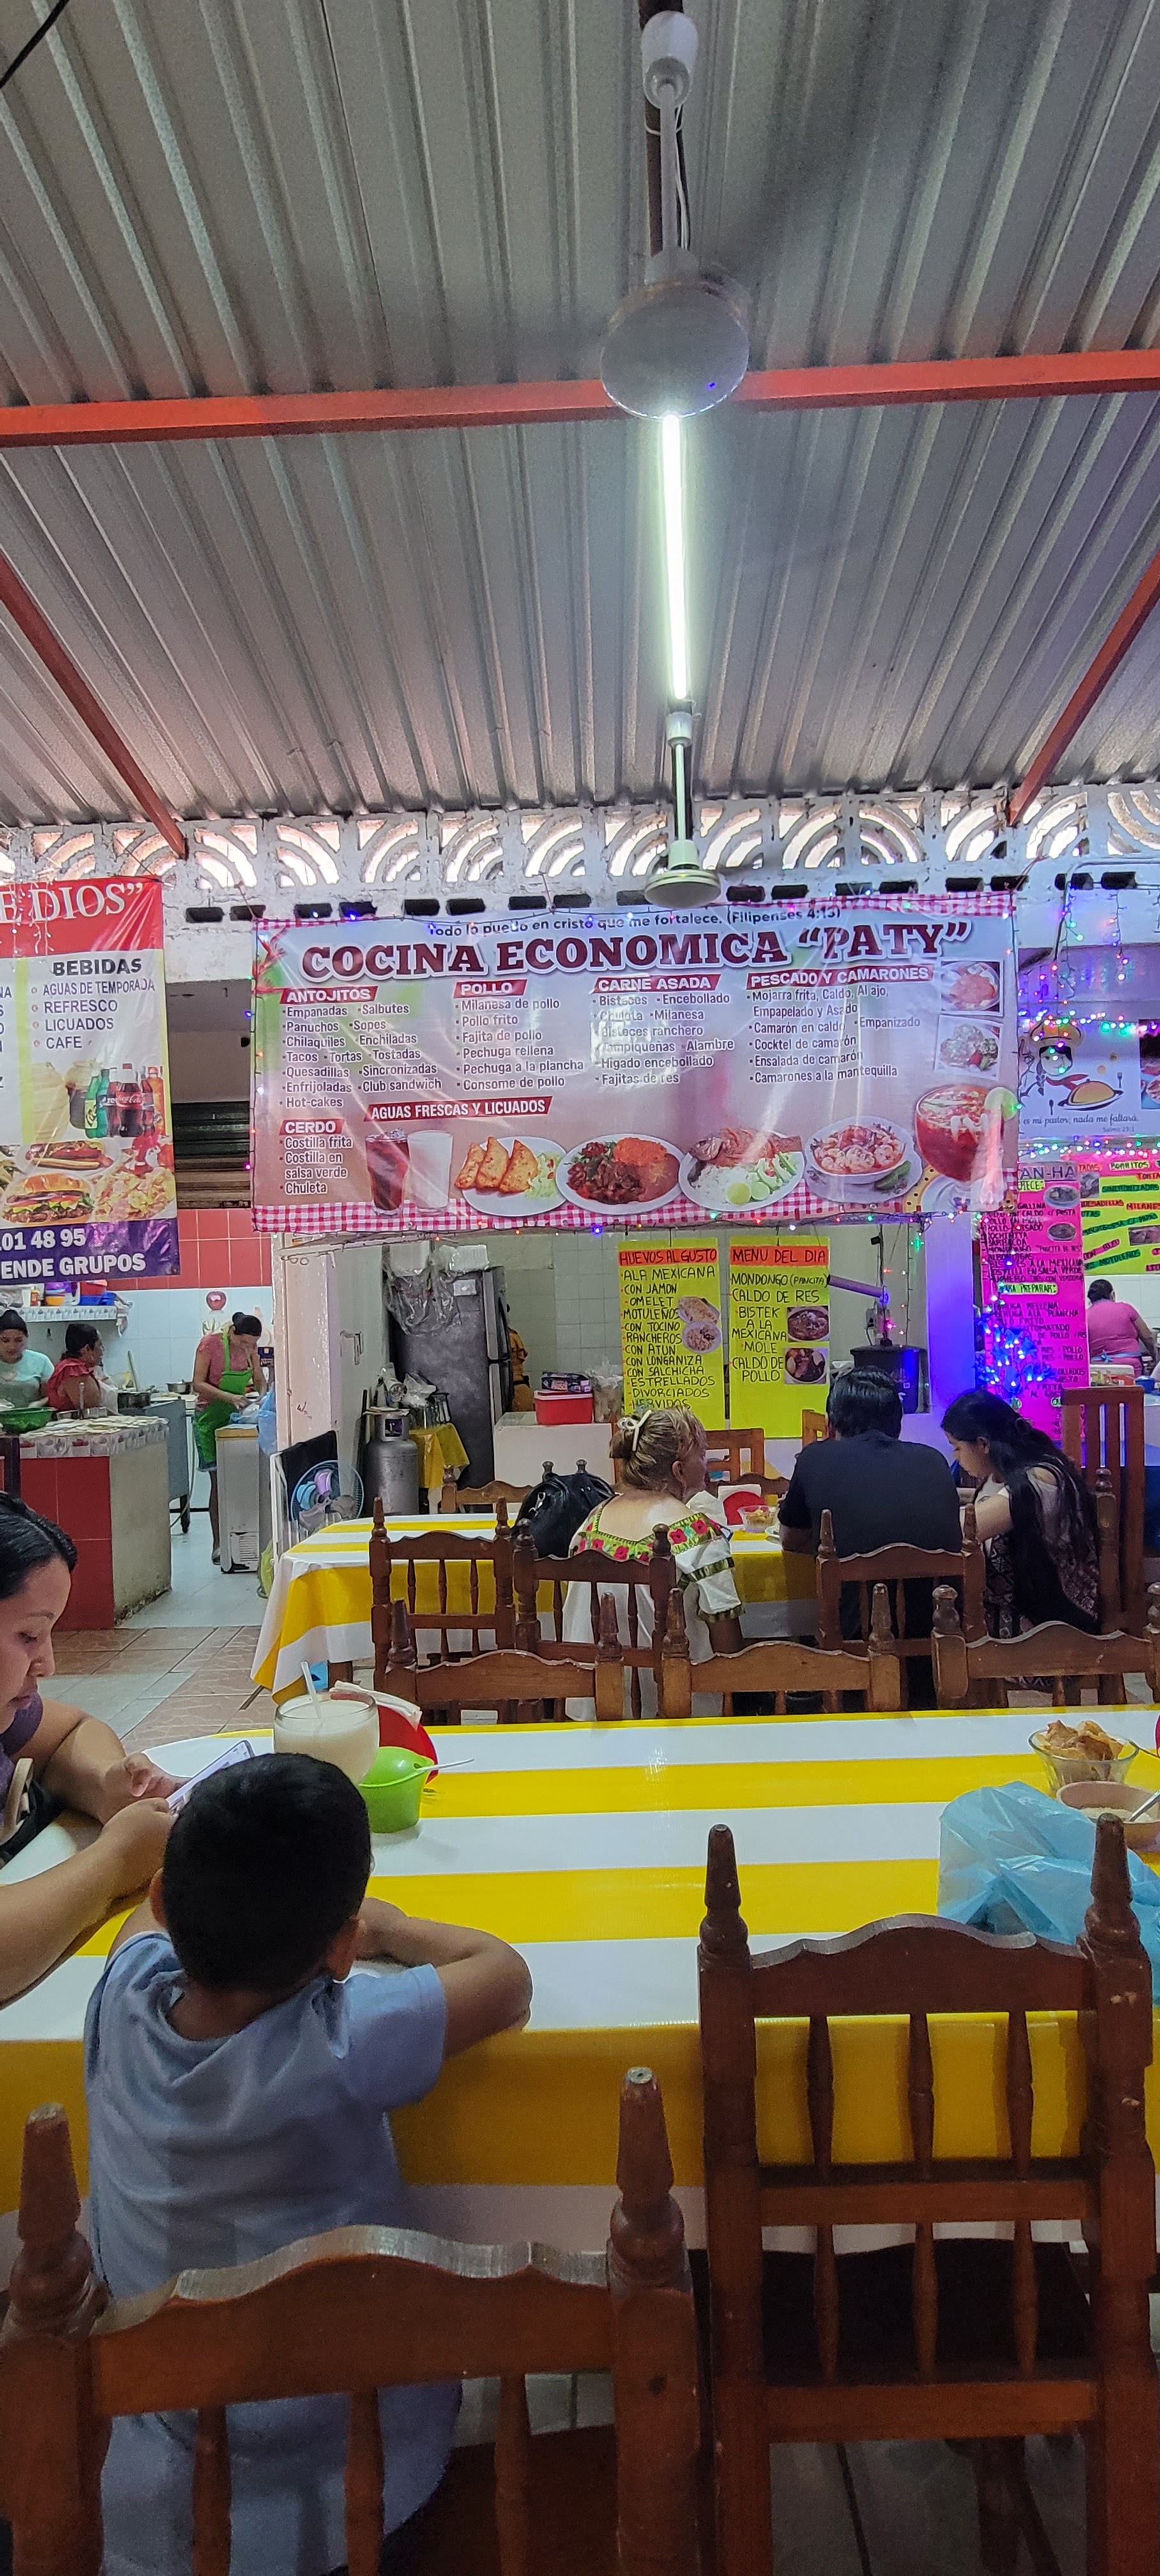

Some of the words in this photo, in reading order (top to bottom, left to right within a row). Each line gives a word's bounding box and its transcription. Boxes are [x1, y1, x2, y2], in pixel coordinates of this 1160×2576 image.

[533, 920, 549, 930] en
[554, 917, 593, 930] cristo
[598, 919, 624, 930] que
[630, 917, 650, 926] me
[655, 914, 722, 926] fortalece.
[728, 906, 802, 924] (Filipenses
[301, 942, 484, 979] COCINA
[497, 930, 788, 970] ECONOMICA
[53, 958, 141, 976] BEBIDAS
[599, 978, 652, 991] CARNE
[657, 977, 711, 989] ASADA
[751, 973, 818, 987] PESCADO
[822, 972, 832, 984] Y
[837, 968, 929, 983] CAMARONES
[43, 982, 77, 996] AGUAS
[80, 982, 92, 994] DE
[95, 979, 155, 993] TEMPORADA
[461, 982, 513, 995] POLLO
[753, 991, 791, 1002] Mojarra
[795, 989, 819, 1001] frita,
[823, 988, 853, 999] Caldo,
[858, 985, 869, 995] Al
[871, 986, 889, 997] ajo,
[287, 989, 370, 1002] ANTOJITOS
[663, 993, 729, 1004] Encebollado
[45, 999, 118, 1013] REFRESCO
[287, 1006, 347, 1019] Empanadas
[362, 1004, 409, 1015] Salbutes
[462, 1000, 510, 1011] Milanesa
[515, 999, 529, 1008] de
[533, 999, 560, 1010] pollo
[754, 1006, 813, 1018] Empapelado
[818, 1007, 823, 1018] y
[827, 1003, 857, 1016] Asado
[462, 1015, 489, 1027] Pollo
[493, 1015, 518, 1025] frito
[655, 1009, 704, 1020] Milanesa
[45, 1018, 114, 1031] LICUADOS
[287, 1022, 339, 1032] Panuchos
[354, 1020, 386, 1032] Sopes
[653, 1025, 703, 1036] ranchero
[754, 1022, 797, 1034] Camarón
[801, 1023, 814, 1032] en
[818, 1020, 845, 1032] caldo
[860, 1017, 920, 1030] Empanizado
[47, 1036, 82, 1048] CAFE
[287, 1036, 345, 1049] Chilaquiles
[360, 1034, 417, 1045] Enchiladas
[462, 1031, 492, 1043] Fajita
[497, 1031, 510, 1041] de
[515, 1030, 542, 1041] pollo
[755, 1038, 791, 1050] Cocktel
[796, 1038, 808, 1049] de
[812, 1036, 856, 1048] camarón
[687, 1039, 734, 1051] Alambre
[287, 1052, 317, 1062] Tacos
[329, 1052, 362, 1062] Tortas
[373, 1049, 420, 1060] Tostadas
[463, 1047, 510, 1059] Pechuga
[515, 1045, 554, 1055] rellena
[755, 1055, 798, 1066] Ensalada
[803, 1054, 814, 1064] de
[819, 1050, 863, 1065] camarón
[464, 1062, 511, 1075] Pechuga
[515, 1063, 521, 1072] a
[526, 1061, 535, 1071] la
[540, 1060, 583, 1072] plancha
[645, 1056, 712, 1068] encebollado
[287, 1067, 349, 1078] Quesadillas
[363, 1064, 437, 1077] Sincronizadas
[755, 1070, 812, 1083] Camarones
[816, 1071, 821, 1080] a
[825, 1070, 833, 1080] la
[838, 1065, 897, 1080] mantequilla
[287, 1082, 351, 1093] Enfrijoladas
[363, 1080, 386, 1092] Club
[390, 1079, 441, 1091] sandwich
[464, 1078, 515, 1091] Consome
[520, 1077, 533, 1087] de
[538, 1076, 564, 1088] pollo
[602, 1074, 639, 1086] Fajitas
[643, 1073, 656, 1083] de
[661, 1073, 679, 1083] res
[287, 1097, 343, 1107] Hot-cakes
[371, 1106, 411, 1119] AGUAS
[415, 1103, 468, 1117] FRESCAS
[471, 1103, 481, 1114] Y
[485, 1100, 545, 1114] LICUADOS
[285, 1121, 336, 1133] CERDO
[286, 1137, 324, 1148] Costilla
[328, 1137, 352, 1147] frita
[286, 1153, 324, 1164] Costilla
[329, 1154, 342, 1162] en
[286, 1167, 312, 1178] salsa
[315, 1167, 347, 1177] verde
[286, 1183, 326, 1193] Chuleta
[31, 1230, 56, 1248] 48
[60, 1228, 86, 1247] 95
[620, 1250, 663, 1266] HUEVOS
[667, 1250, 680, 1263] AL
[681, 1248, 717, 1262] GUSTO
[733, 1249, 768, 1262] MENU
[775, 1250, 798, 1263] DEL
[805, 1250, 825, 1263] DIA
[59, 1253, 146, 1276] GRUPOS
[652, 1266, 715, 1280] MEXICANA
[731, 1273, 788, 1286] MONDONGO
[790, 1273, 828, 1288] (PANCITA)
[625, 1284, 642, 1294] CON
[646, 1283, 677, 1294] JAMON
[630, 1296, 674, 1307] OMELET
[732, 1289, 770, 1302] CALDO
[777, 1291, 790, 1303] DE
[796, 1290, 820, 1303] RES
[623, 1307, 680, 1319] MOTULEÑOS
[739, 1307, 781, 1319] BISTEK
[625, 1322, 642, 1331] CON
[647, 1322, 680, 1331] TOCINO
[746, 1319, 754, 1329] A
[759, 1320, 772, 1330] LA
[626, 1332, 682, 1344] RANCHEROS
[732, 1329, 787, 1341] MEXICANA
[625, 1344, 643, 1354] CON
[648, 1344, 676, 1354] ATUN
[744, 1341, 777, 1354] MOLE
[626, 1357, 643, 1367] CON
[646, 1354, 702, 1365] LONGANIZA
[733, 1357, 768, 1369] CALDO
[771, 1357, 784, 1369] DE
[627, 1368, 643, 1377] CON
[648, 1365, 704, 1376] SALCHICHA
[742, 1370, 780, 1383] POLLO
[631, 1376, 715, 1387] ESTRELLADOS
[633, 1388, 710, 1398] DIVORCIADOS
